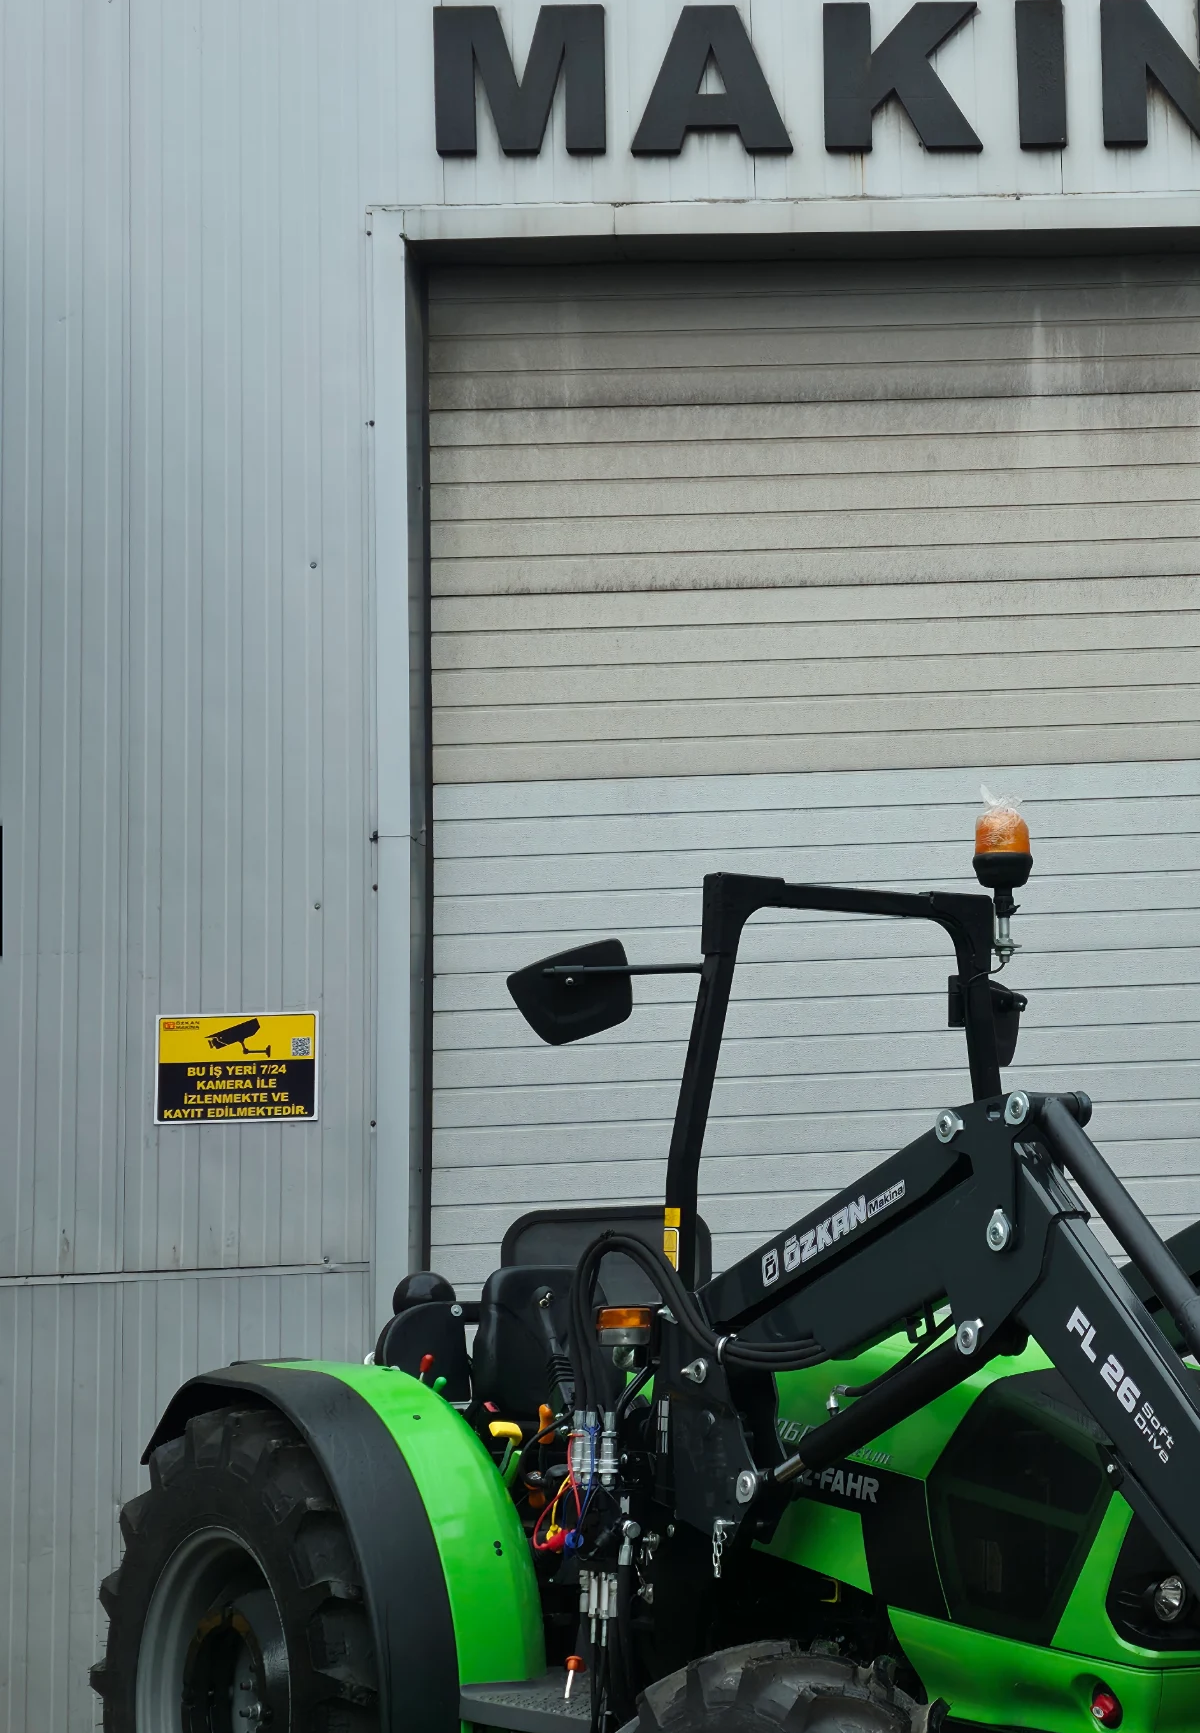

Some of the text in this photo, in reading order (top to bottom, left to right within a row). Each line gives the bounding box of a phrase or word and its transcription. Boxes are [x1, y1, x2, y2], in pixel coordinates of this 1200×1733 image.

[187, 1063, 287, 1078] BU İŞ YERİ 7/24
[196, 1077, 277, 1090] KAMERA İLE
[164, 1104, 308, 1119] KAYIT EDİLMEKTEDİR.
[184, 1092, 289, 1105] İZLENMEKTE VE
[784, 1195, 867, 1272] ÖZKAN
[868, 1185, 904, 1215] Makina
[1066, 1305, 1141, 1413] FL 26
[1134, 1413, 1169, 1464] Drive
[1141, 1401, 1175, 1450] Soft
[802, 1467, 880, 1504] Z-FAHR
